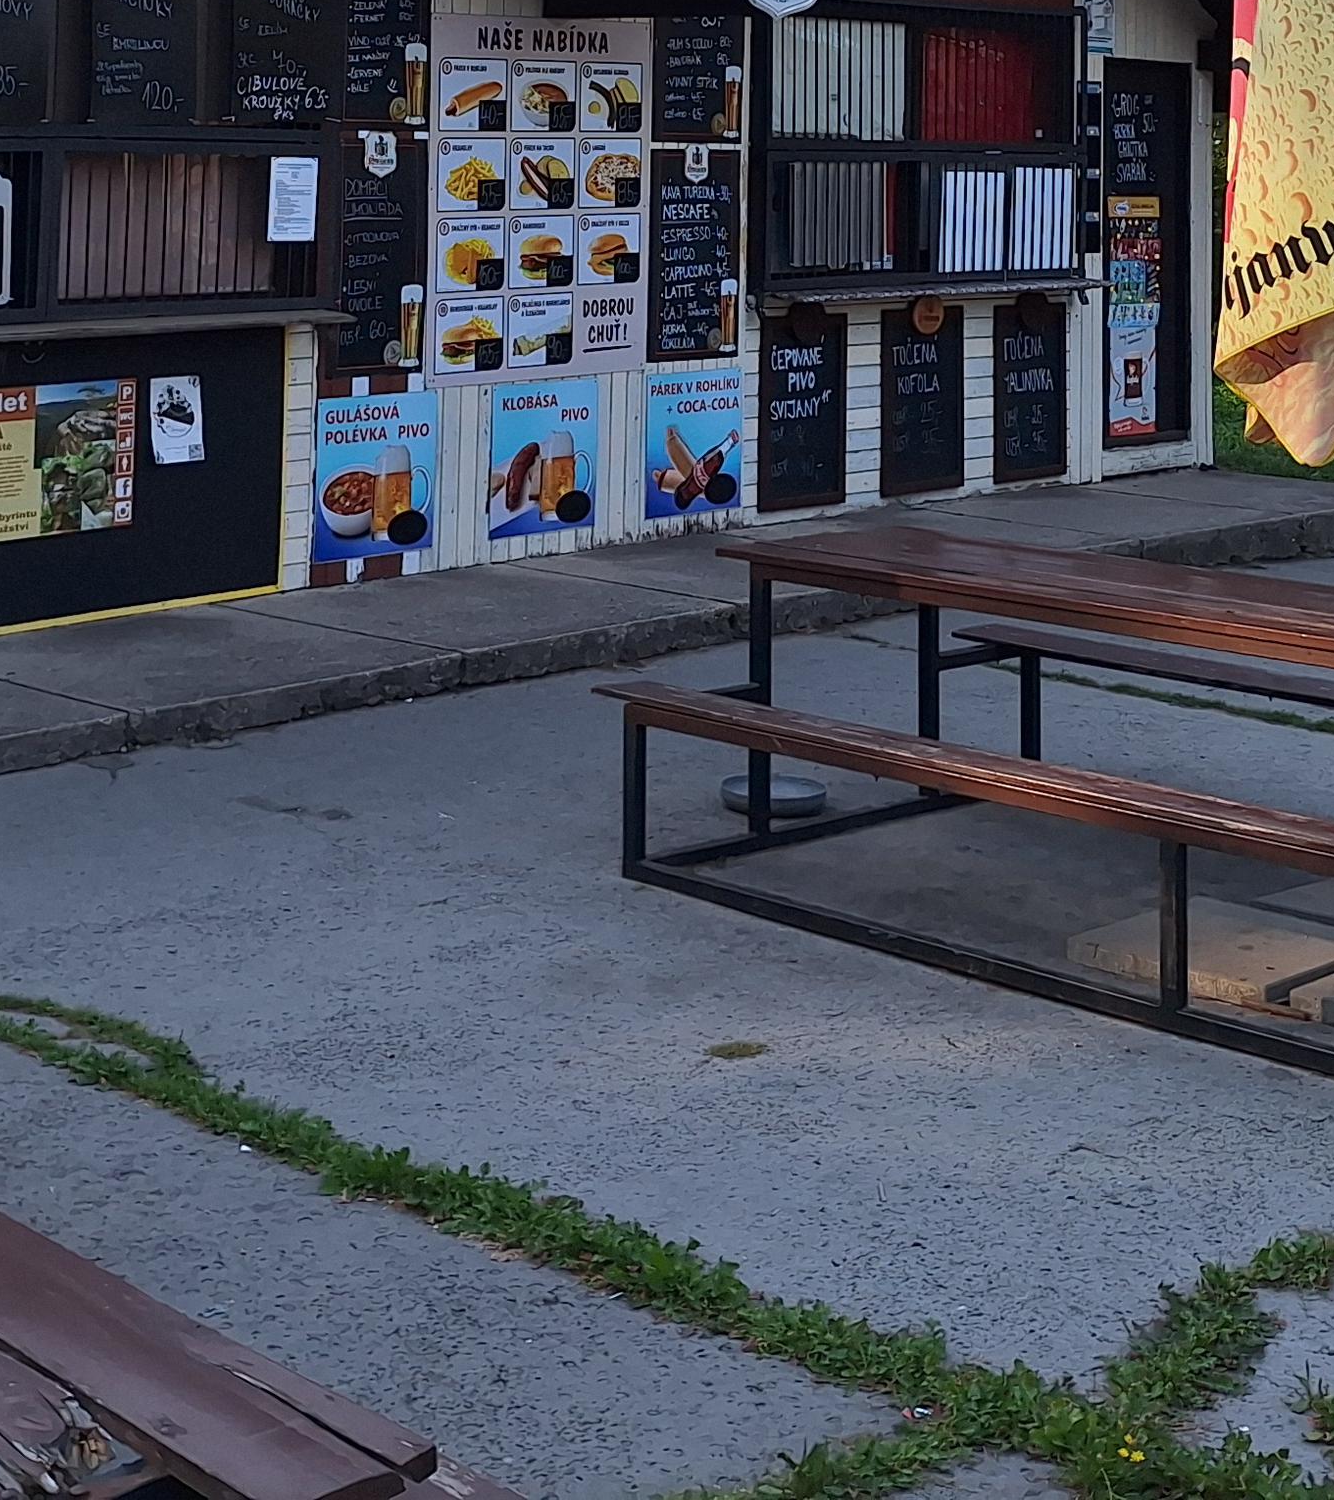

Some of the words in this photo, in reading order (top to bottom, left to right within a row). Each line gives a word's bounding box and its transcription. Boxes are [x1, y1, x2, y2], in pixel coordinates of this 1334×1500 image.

[478, 21, 524, 51] NAŠE
[532, 25, 609, 54] NABÍDKA
[662, 204, 710, 220] NESCAFE
[663, 226, 710, 243] ESPRESSO
[664, 247, 695, 261] LUNGO
[664, 283, 697, 299] LATTE
[583, 298, 634, 318] DOBROU
[650, 378, 684, 397] PÁREK
[686, 381, 694, 393] V
[695, 375, 740, 393] ROHLÍKU
[788, 371, 815, 393] PIVO
[897, 372, 940, 396] KOFOLA
[502, 392, 558, 411] KLOBÁSA
[677, 397, 739, 414] COCA-COLA
[770, 396, 820, 420] SVIJANY
[325, 401, 400, 425] GULÁŠOVÁ
[561, 407, 590, 422] PIVO
[325, 426, 388, 445] POLÉVKA
[398, 423, 430, 439] PIVO
